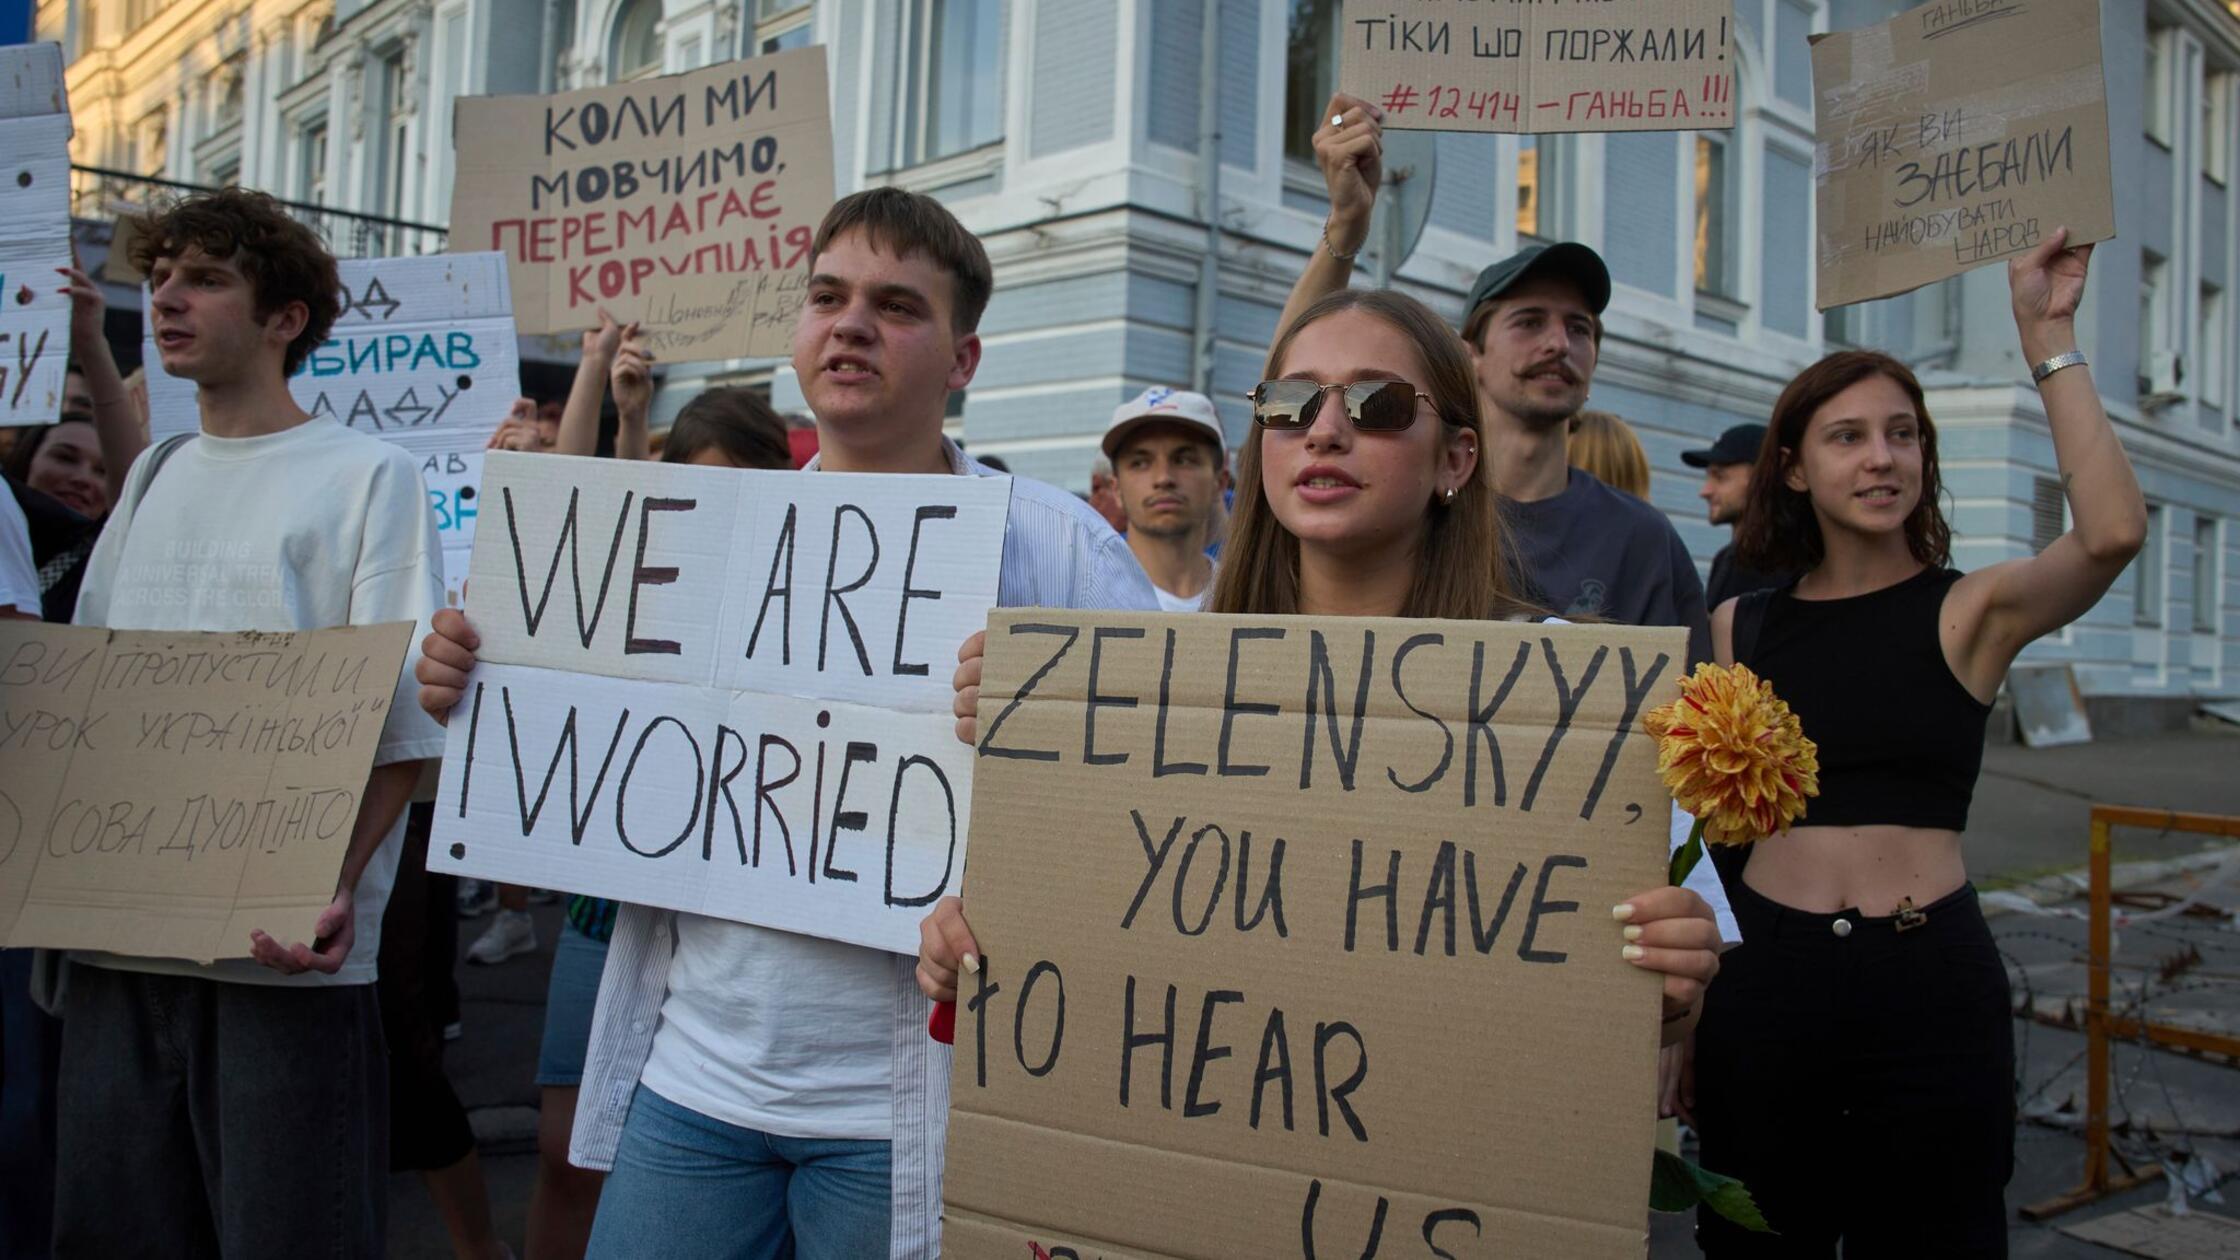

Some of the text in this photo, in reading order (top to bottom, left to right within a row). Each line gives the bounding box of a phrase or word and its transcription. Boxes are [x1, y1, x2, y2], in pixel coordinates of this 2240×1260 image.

[544, 70, 776, 156] КОЛИ МИ
[1382, 83, 1519, 122] #12414
[1859, 108, 1963, 169] ЯК ВИ
[1954, 218, 2042, 262] НАРОД
[289, 332, 481, 379] БИРАВ
[503, 486, 957, 676] WE ARE
[0, 641, 96, 692] ВИ
[48, 799, 156, 857] СОВА
[1120, 809, 1587, 964] YOU HAVE
[1119, 974, 1370, 1143] HEAR
